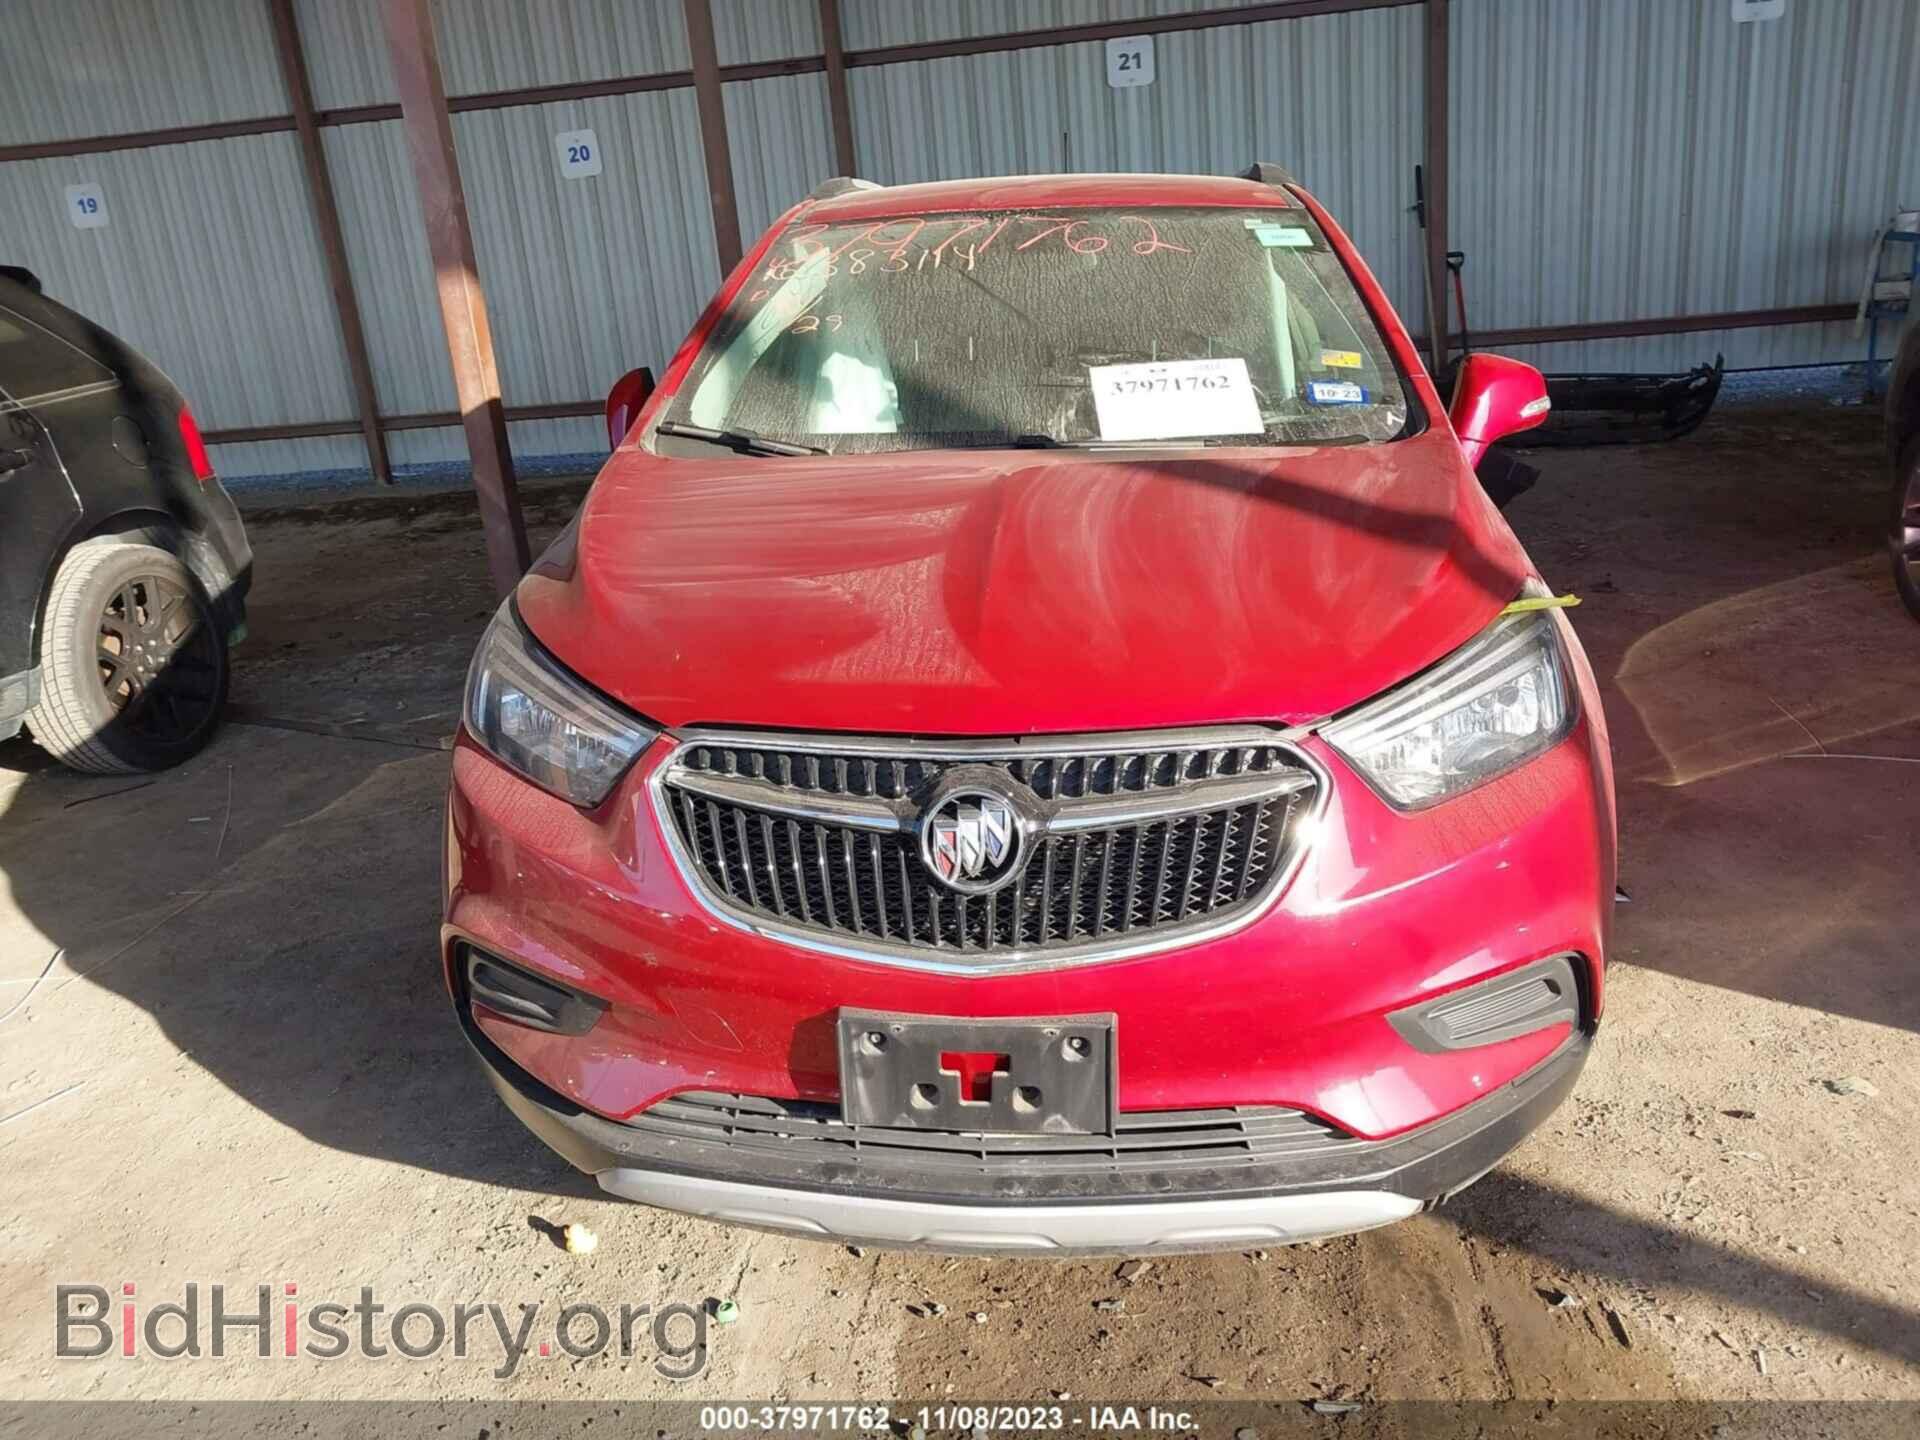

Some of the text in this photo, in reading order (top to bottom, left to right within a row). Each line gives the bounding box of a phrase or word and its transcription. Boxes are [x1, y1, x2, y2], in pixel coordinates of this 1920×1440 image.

[1118, 52, 1142, 71] 21
[568, 145, 590, 163] 20
[77, 197, 98, 214] 19
[1111, 375, 1231, 395] 37971762
